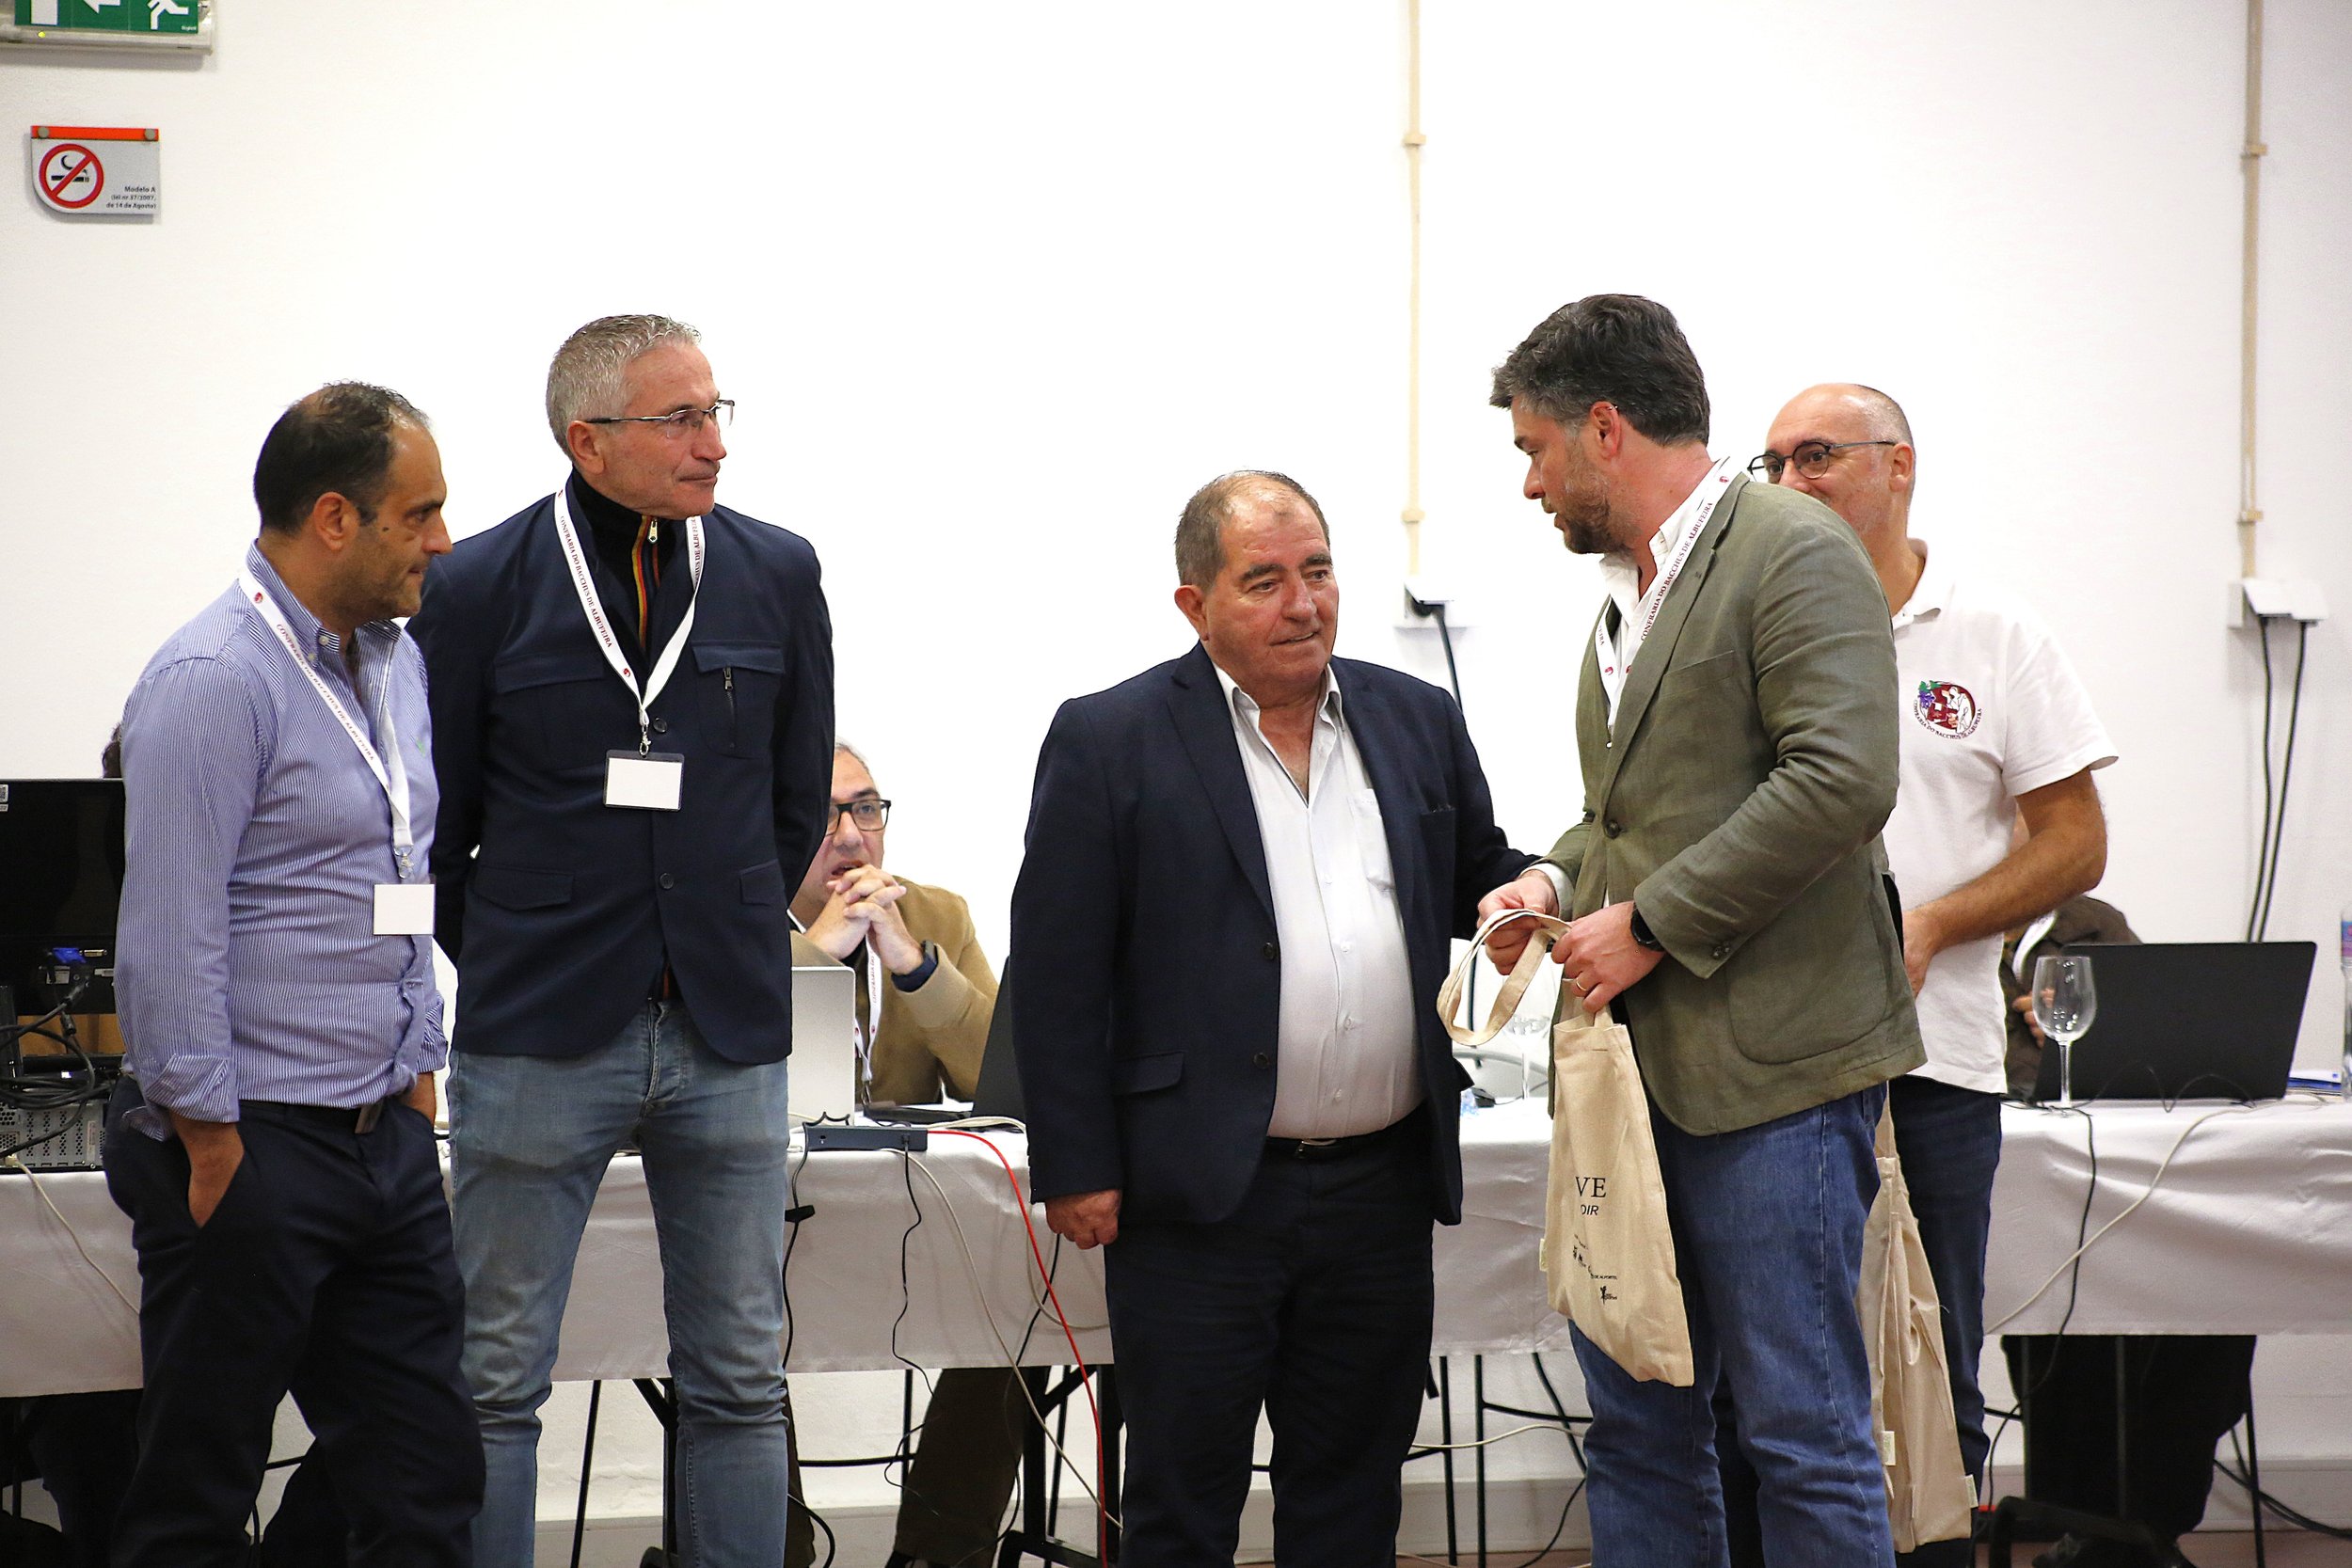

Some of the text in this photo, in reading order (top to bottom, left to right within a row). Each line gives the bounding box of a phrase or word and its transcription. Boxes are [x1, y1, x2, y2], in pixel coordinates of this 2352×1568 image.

[560, 515, 612, 647] CONFRARIA DO BACCHUS DE ALBUFEIRA
[695, 550, 700, 561] DE
[1641, 502, 1712, 641] CONFRARIA DO BACCHUS DE ALBUFEIRA
